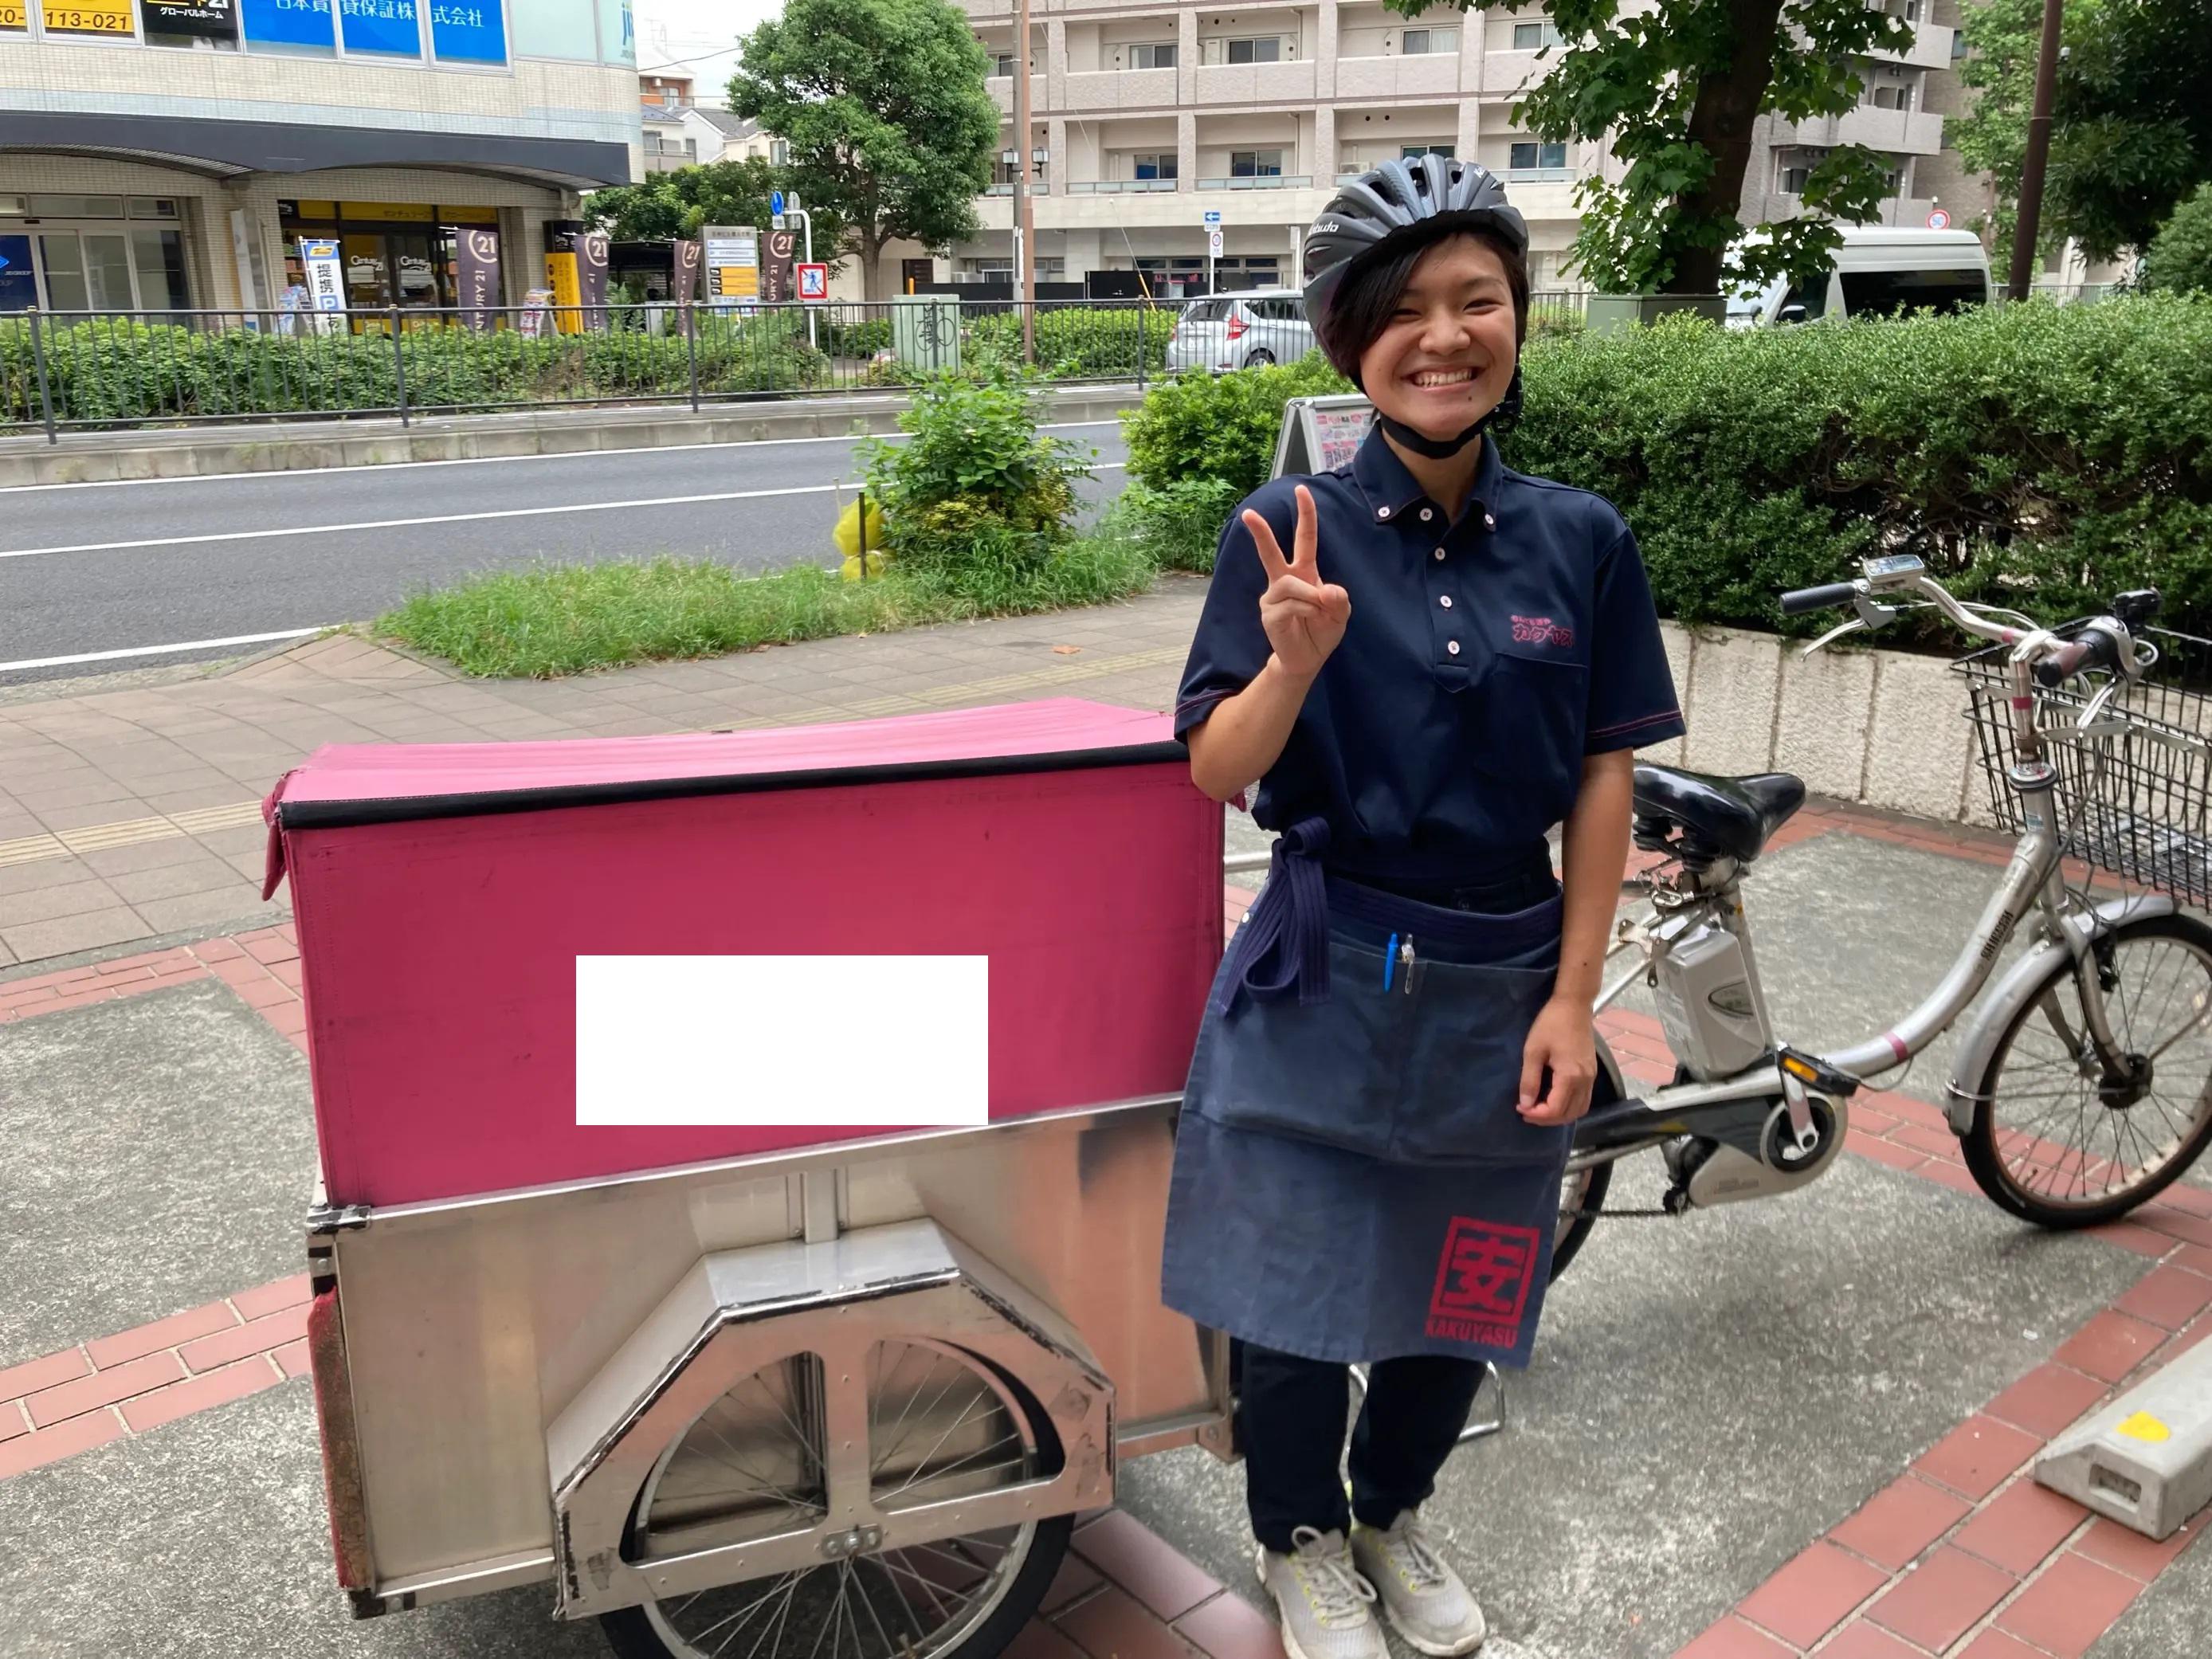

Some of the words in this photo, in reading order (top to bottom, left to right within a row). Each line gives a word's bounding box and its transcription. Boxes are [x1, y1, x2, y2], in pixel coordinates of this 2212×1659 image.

[0, 9, 25, 24] 0-
[46, 11, 127, 29] 113-021
[160, 6, 224, 19] グローバルホーム
[1512, 624, 1573, 648] カクヤス
